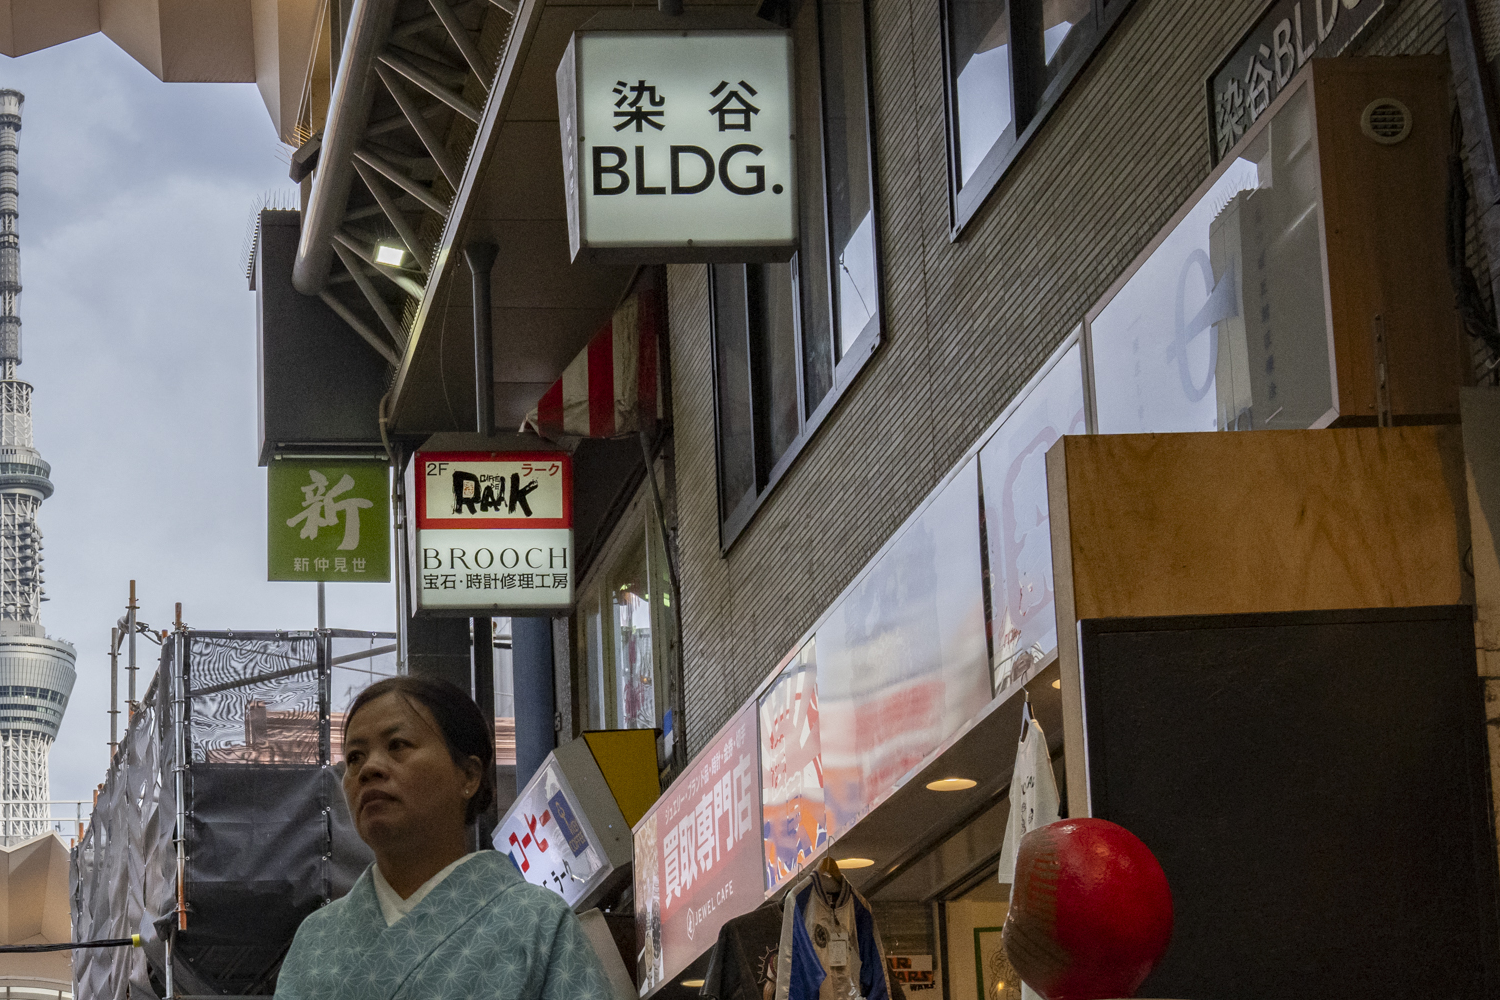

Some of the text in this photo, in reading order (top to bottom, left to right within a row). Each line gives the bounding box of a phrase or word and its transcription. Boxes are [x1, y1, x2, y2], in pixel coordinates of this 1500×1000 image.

[612, 79, 761, 132] 染谷
[592, 143, 784, 195] BLDG.
[426, 462, 450, 476] 2F
[521, 463, 560, 477] ラーク
[286, 469, 374, 551] 新
[293, 557, 367, 572] 新仲見世
[423, 547, 568, 570] BROOCH
[423, 573, 569, 590] 宝石・時計修理工房
[509, 809, 551, 873] コーヒー
[663, 752, 753, 910] 買取専門店
[694, 879, 735, 927] JEWEL CAFE
